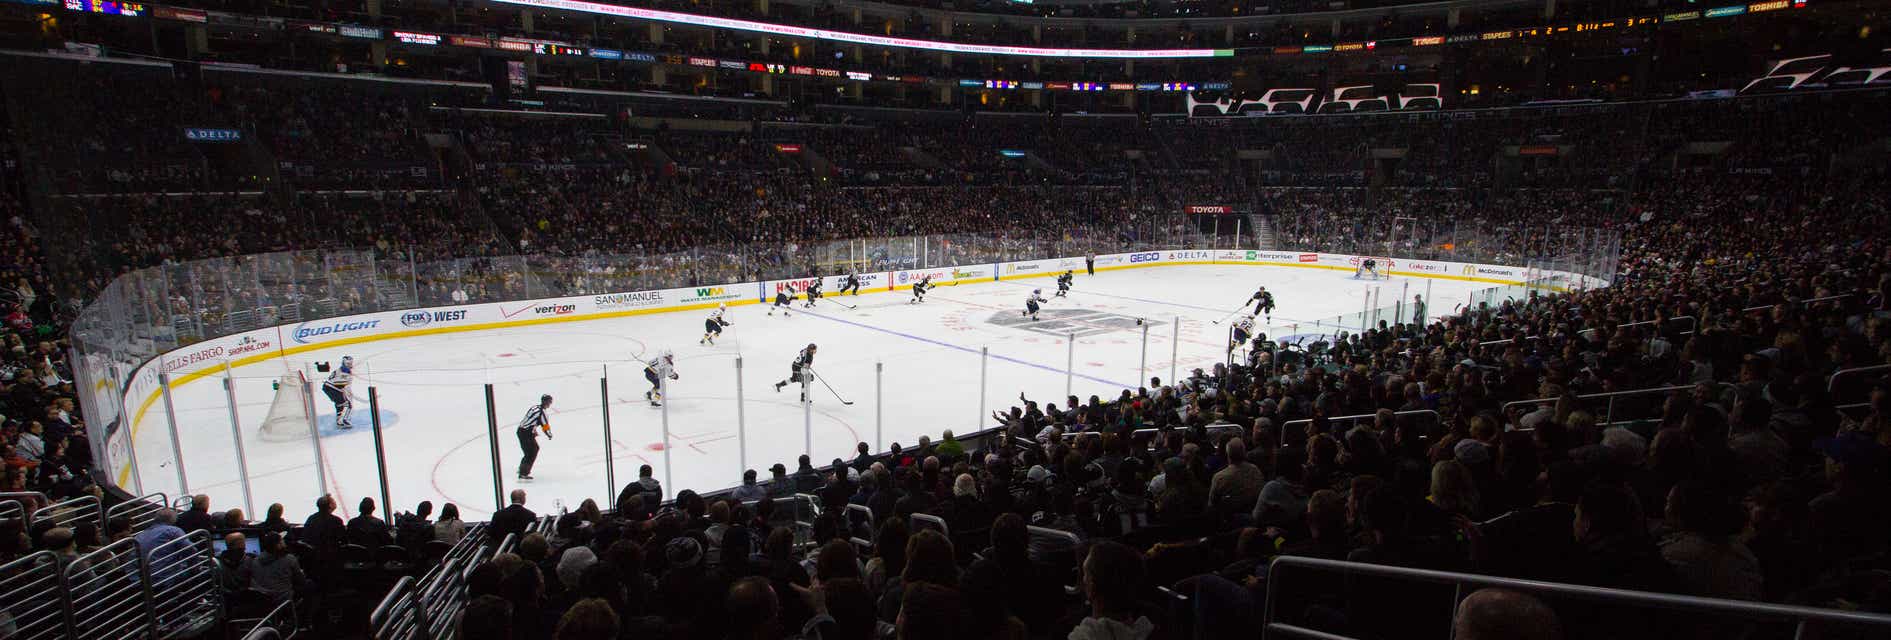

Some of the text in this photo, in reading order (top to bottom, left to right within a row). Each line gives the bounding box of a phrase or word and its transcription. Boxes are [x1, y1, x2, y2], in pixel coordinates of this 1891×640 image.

[1748, 1, 1789, 12] TOSHIBA
[816, 68, 839, 76] TOYOTA
[200, 130, 240, 138] DELTA
[1192, 206, 1224, 214] TOYOTA
[1130, 252, 1160, 263] GEICO
[1178, 251, 1208, 260] DELTA
[595, 295, 616, 306] SAN
[624, 291, 663, 303] MANUEL
[535, 303, 576, 315] verizon
[407, 310, 467, 322] FOX WEST
[190, 346, 224, 364] FARGO
